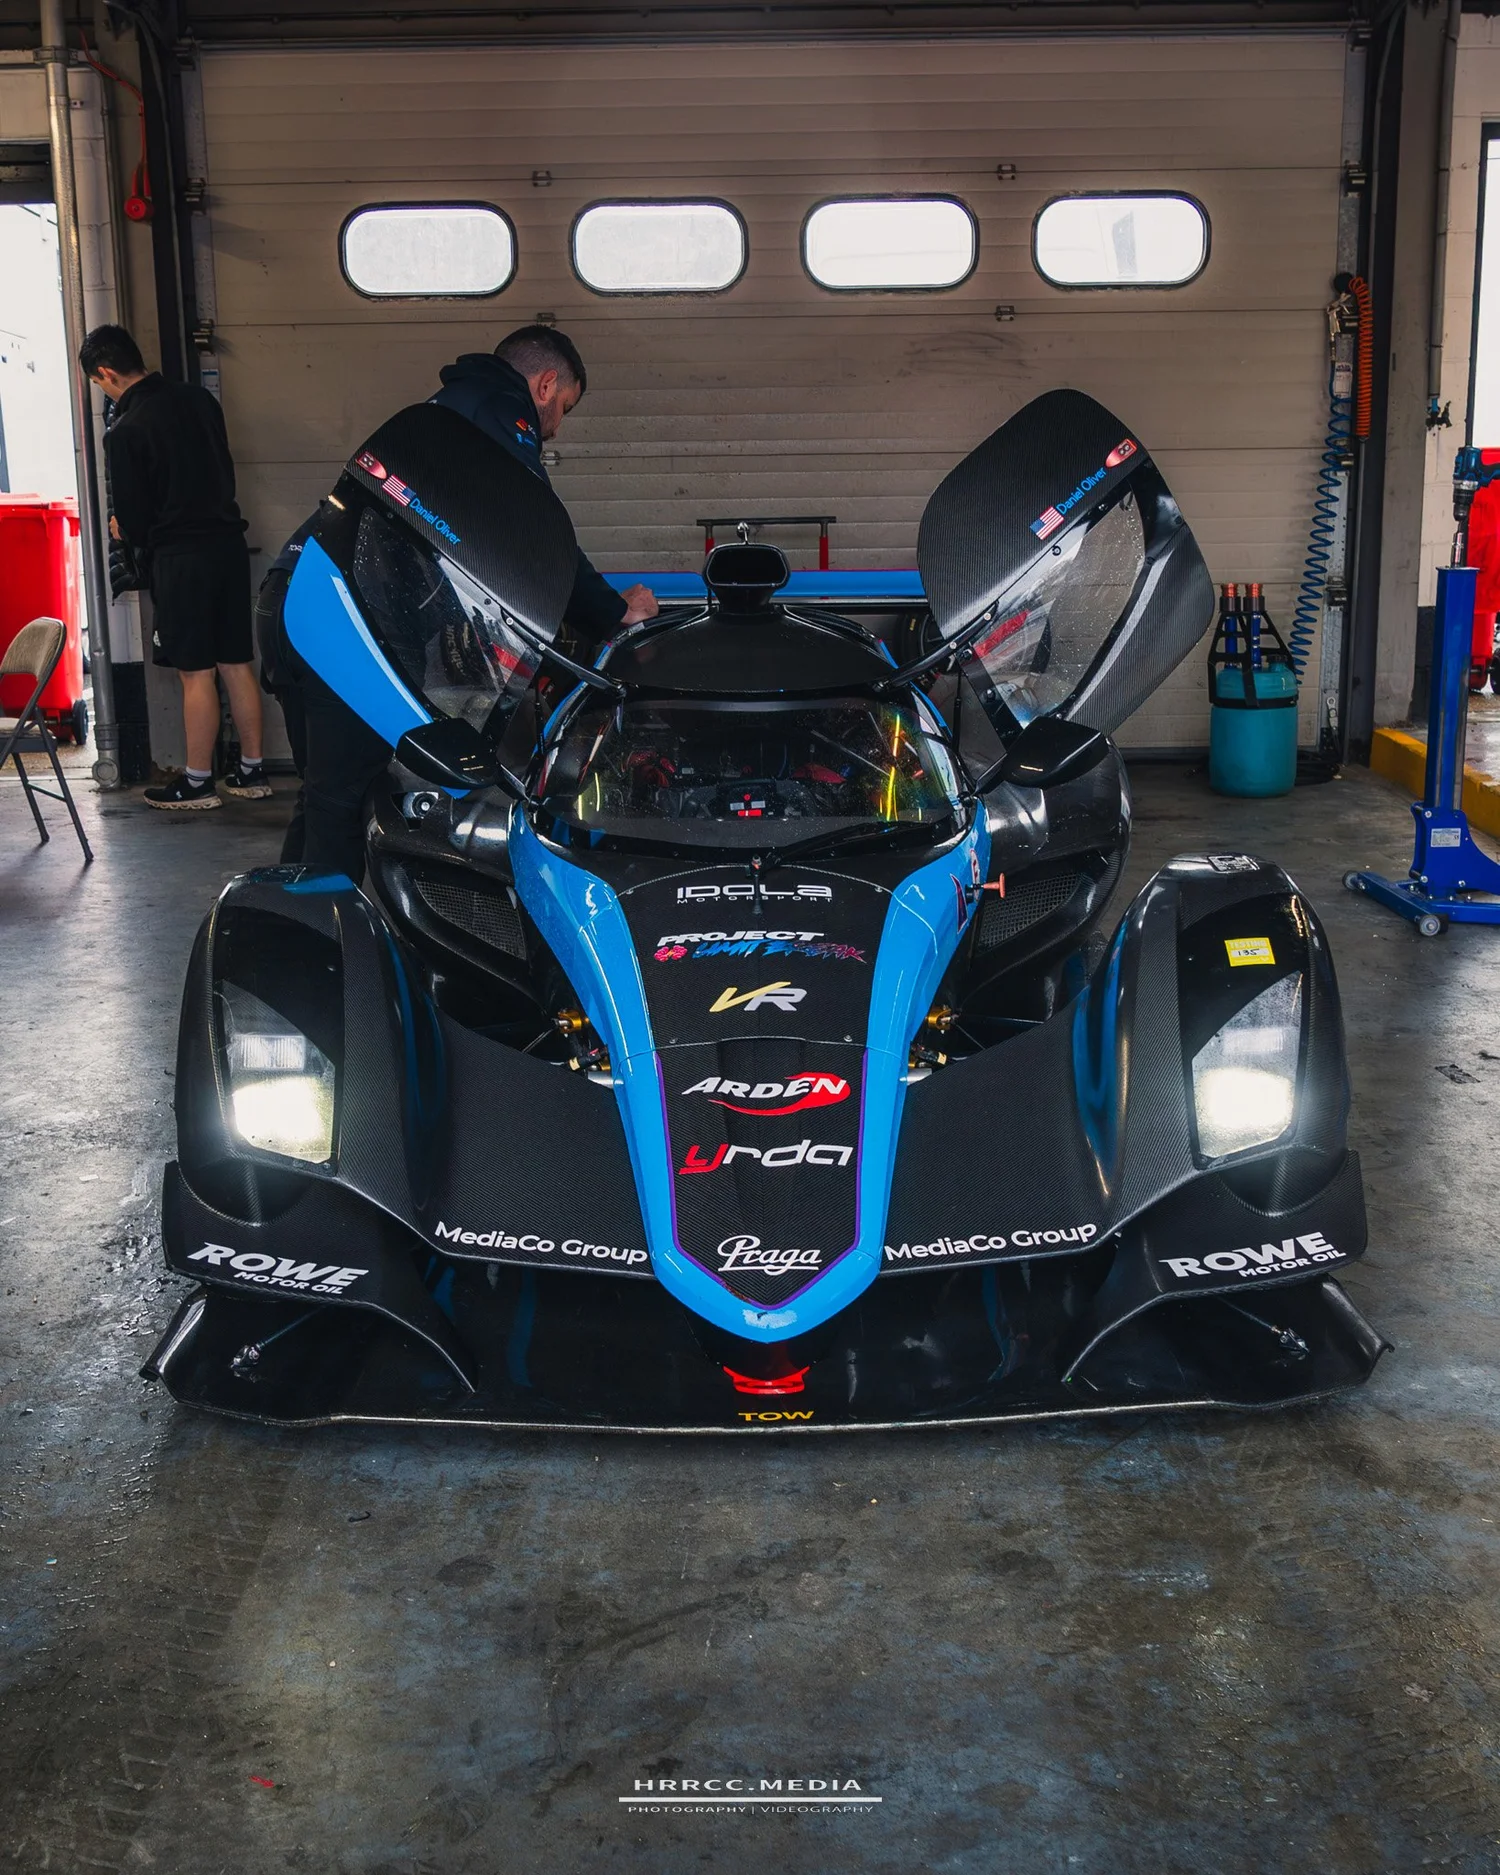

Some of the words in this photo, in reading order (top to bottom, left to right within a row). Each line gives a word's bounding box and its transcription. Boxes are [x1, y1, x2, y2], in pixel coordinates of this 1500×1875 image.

[1055, 487, 1085, 515] Daniel
[1081, 467, 1107, 491] Oliver
[409, 497, 439, 525] Daniel
[435, 519, 461, 545] Oliver
[677, 895, 833, 904] MOTORSPORT
[657, 930, 824, 947] PROJECT
[681, 1076, 847, 1099] ARDEN
[434, 1221, 555, 1252] MediaCo
[560, 1239, 648, 1265] Group
[717, 1234, 822, 1276] Praga
[884, 1234, 1007, 1261] MediaCo
[1010, 1223, 1097, 1247] Group
[1158, 1231, 1335, 1278] ROWE
[187, 1241, 370, 1287] ROWE
[1238, 1257, 1312, 1278] MOTOR
[1314, 1249, 1347, 1262] OIL
[233, 1271, 310, 1290] MOTOR
[311, 1284, 343, 1295] OIL
[738, 1410, 815, 1422] TOW
